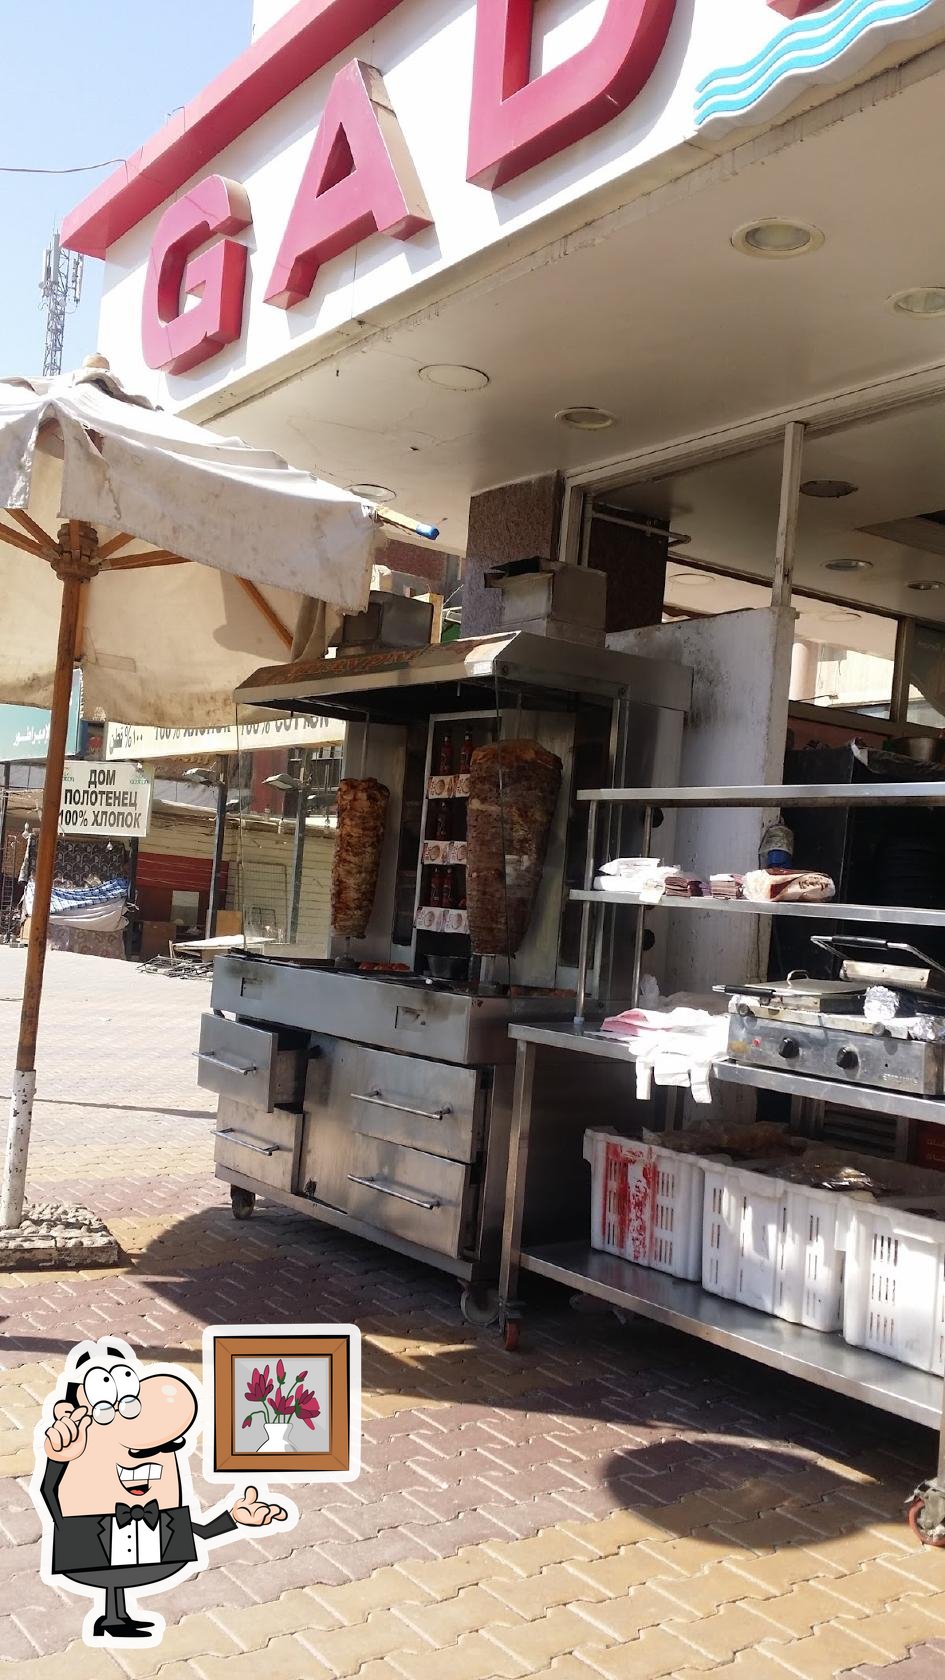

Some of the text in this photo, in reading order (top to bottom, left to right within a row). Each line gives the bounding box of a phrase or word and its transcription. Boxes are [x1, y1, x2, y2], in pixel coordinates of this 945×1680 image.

[142, 0, 674, 376] GAD
[88, 769, 116, 788] ДОМ
[64, 789, 138, 810] ПОЛОТЕНЕЦ
[60, 809, 141, 829] 100% ХЛОПОК
